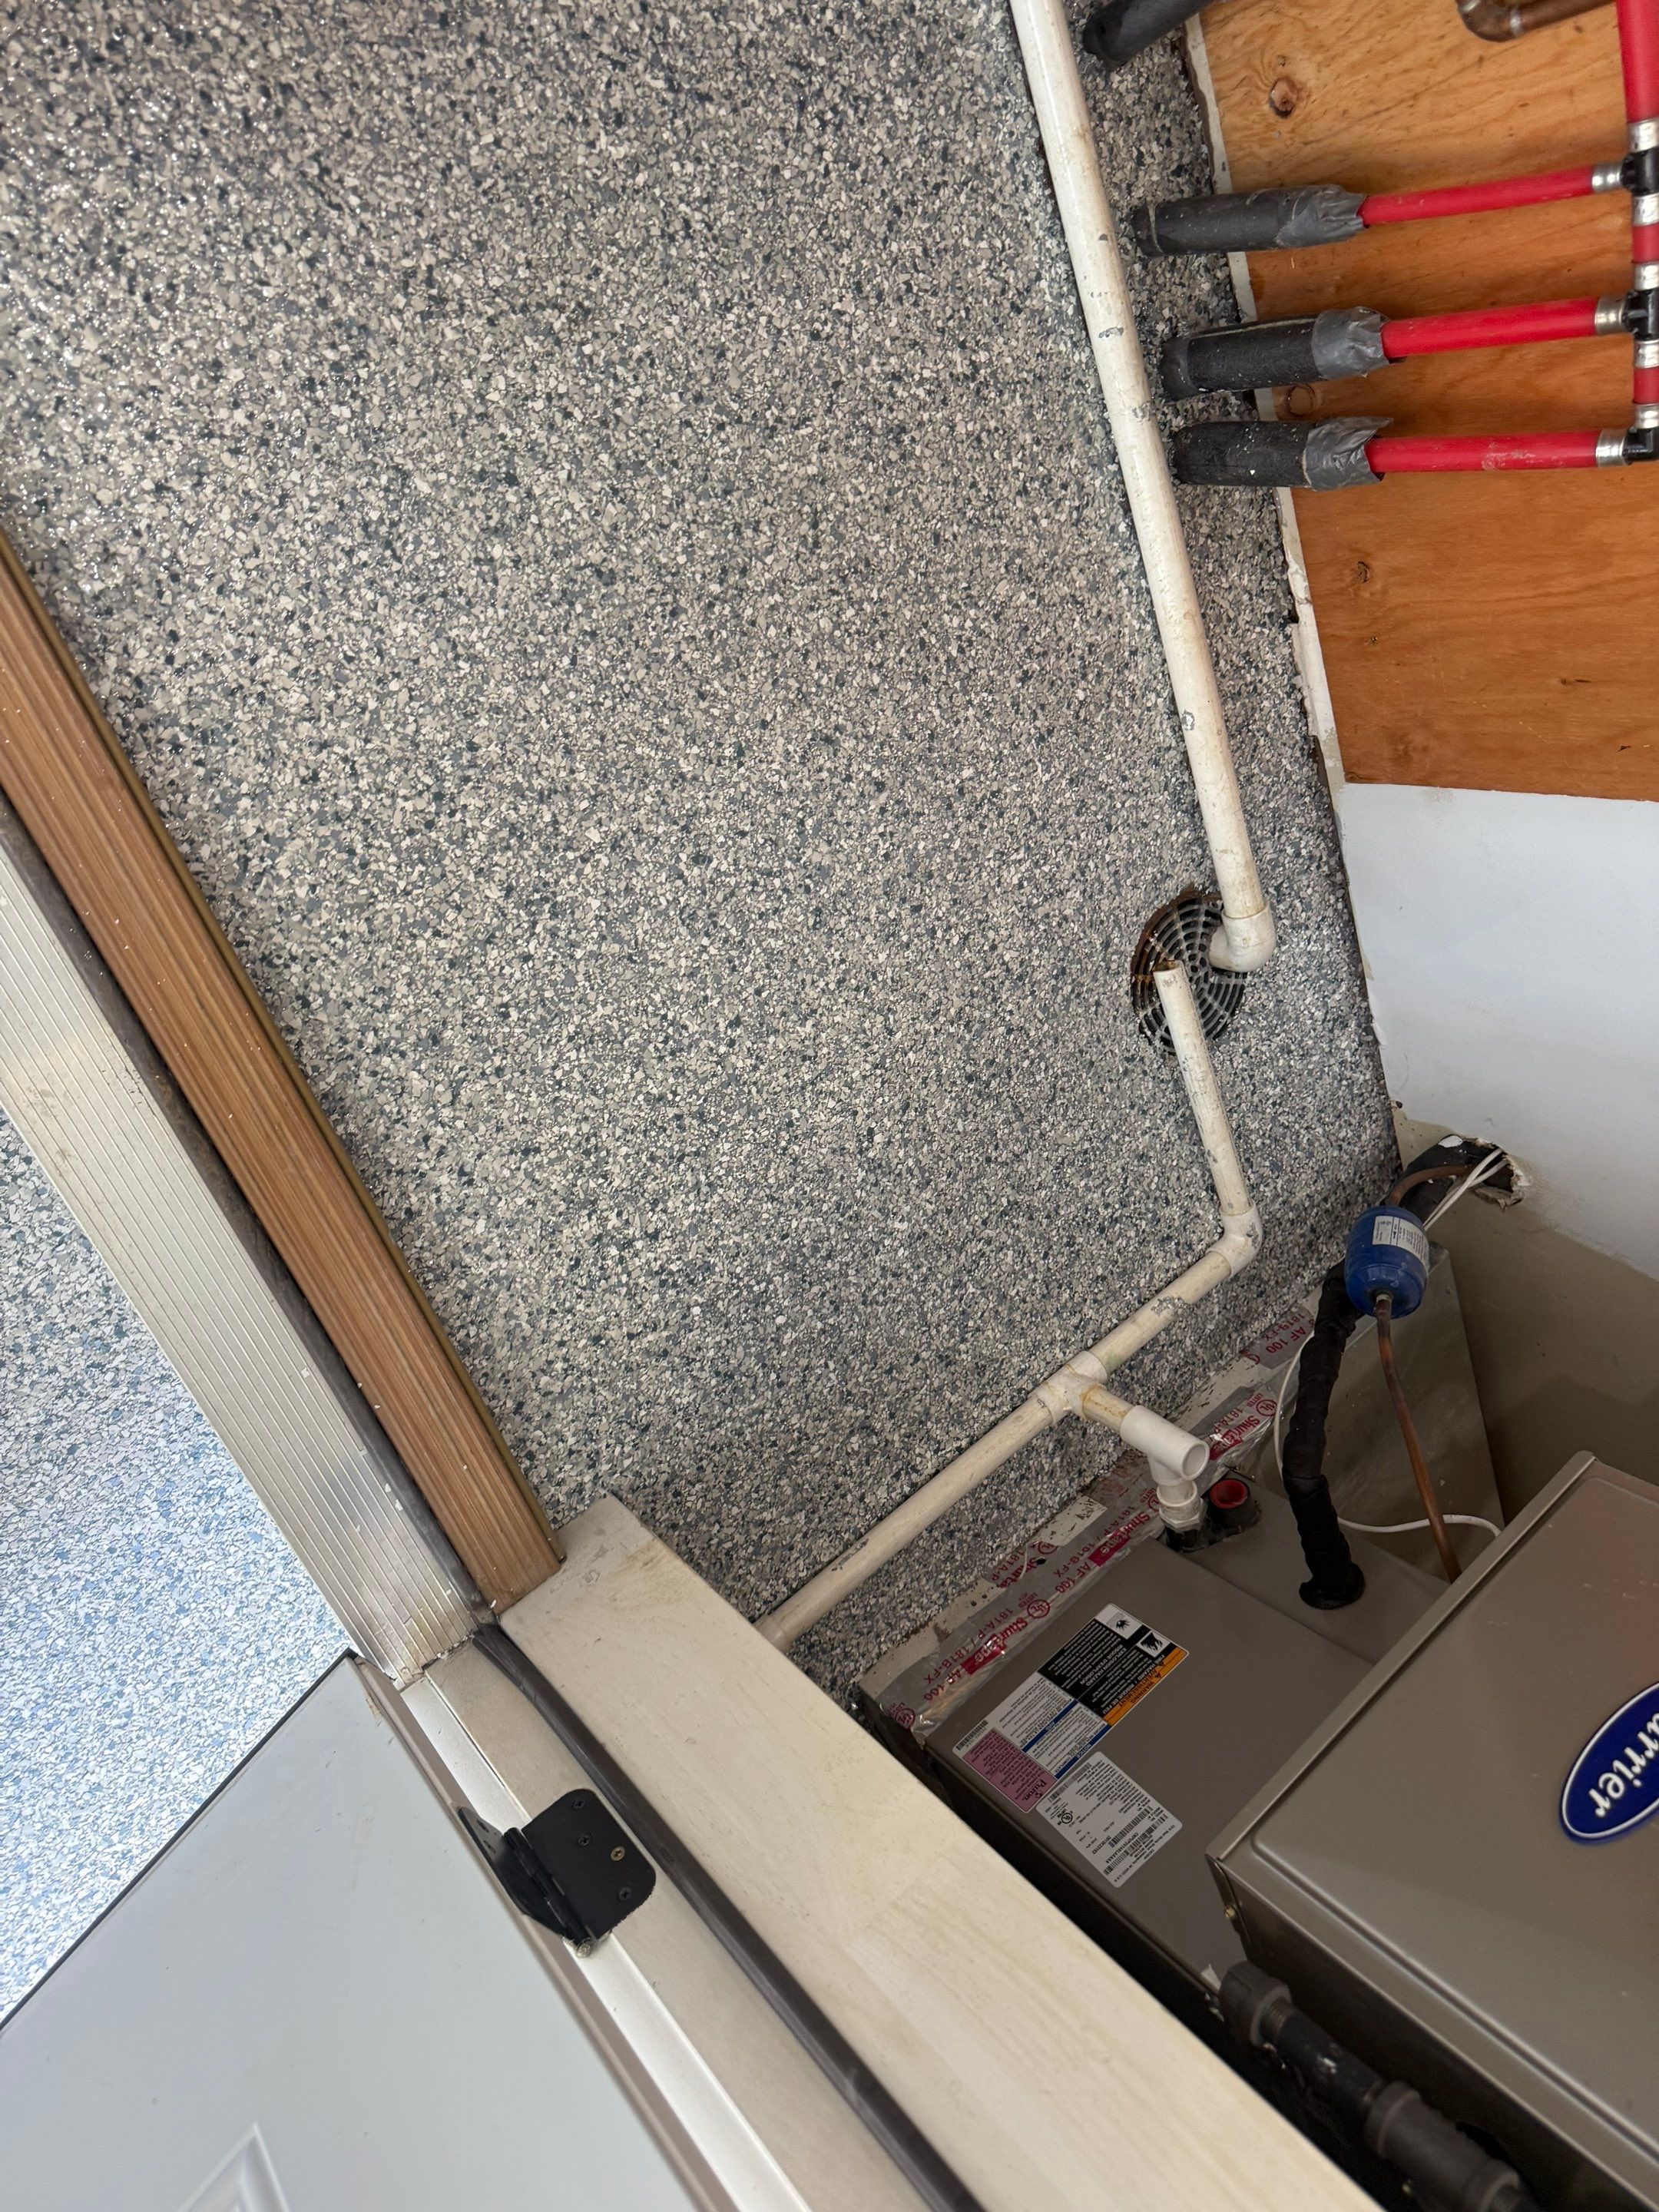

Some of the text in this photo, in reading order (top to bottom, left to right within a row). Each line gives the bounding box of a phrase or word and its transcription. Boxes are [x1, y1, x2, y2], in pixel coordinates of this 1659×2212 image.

[1265, 1325, 1306, 1354] AF 100
[1073, 1561, 1091, 1578] AF
[1053, 1575, 1075, 1594] 100
[1154, 1654, 1164, 1664] FIRE
[1084, 1668, 1104, 1686] HAZARD
[1137, 1663, 1155, 1681] HAZARD
[922, 1681, 946, 1703] 100
[1129, 1680, 1154, 1704] WARNING
